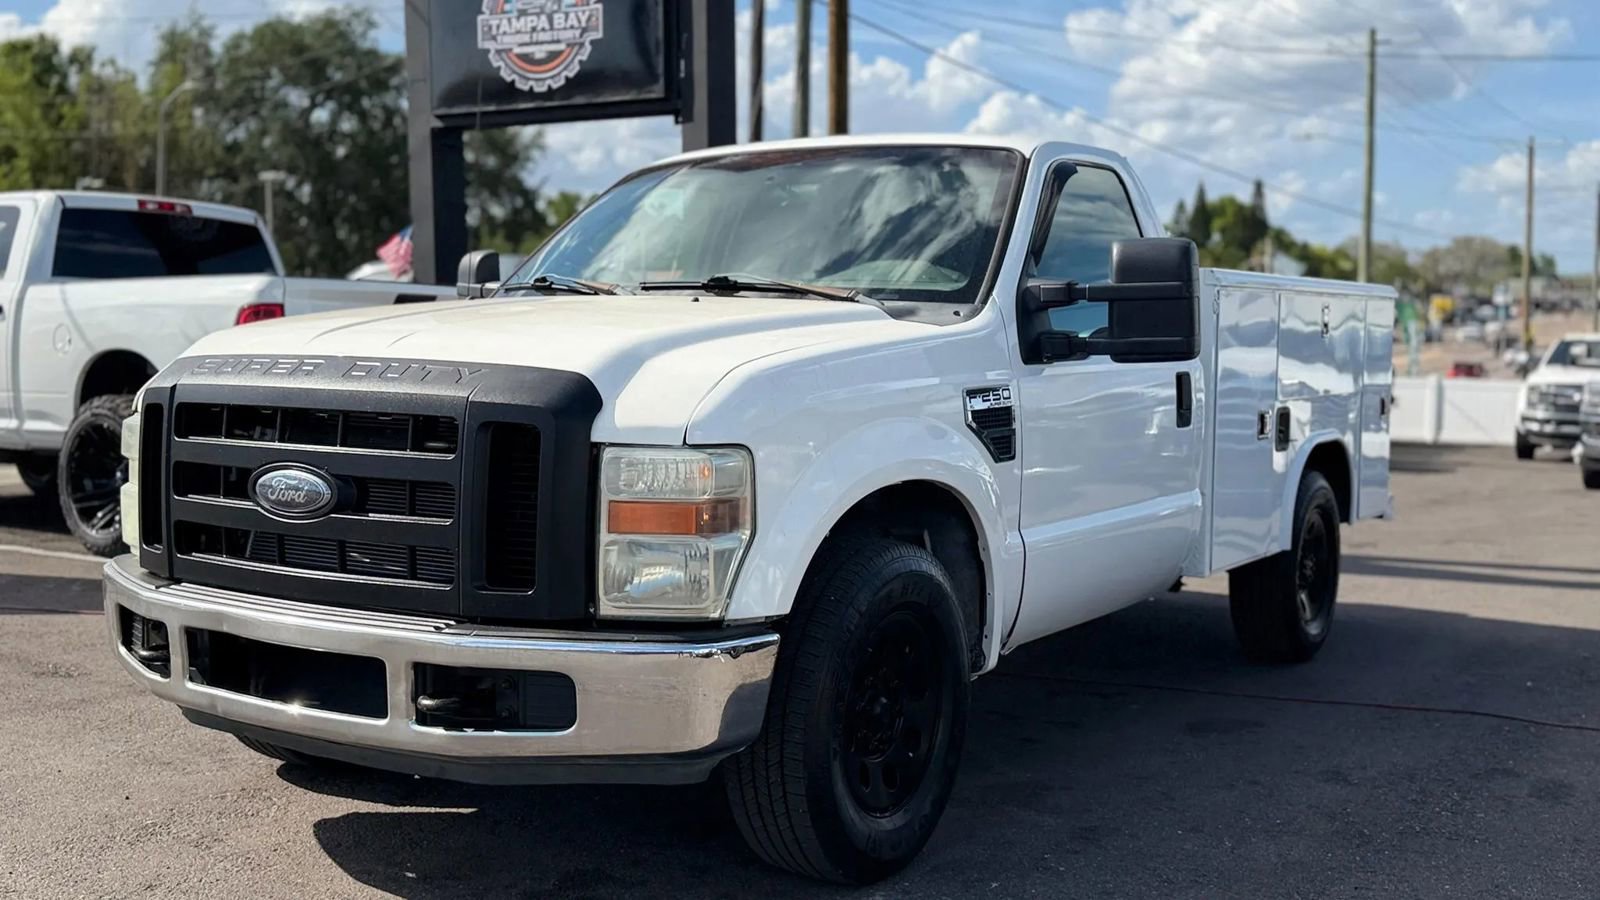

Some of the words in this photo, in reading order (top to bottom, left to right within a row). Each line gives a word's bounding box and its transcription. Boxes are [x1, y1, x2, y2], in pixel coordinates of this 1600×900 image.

[489, 15, 550, 34] TAMPA
[553, 11, 590, 28] BAY
[191, 358, 325, 375] SUPER
[341, 361, 486, 384] DUTY
[267, 476, 308, 503] Ford
